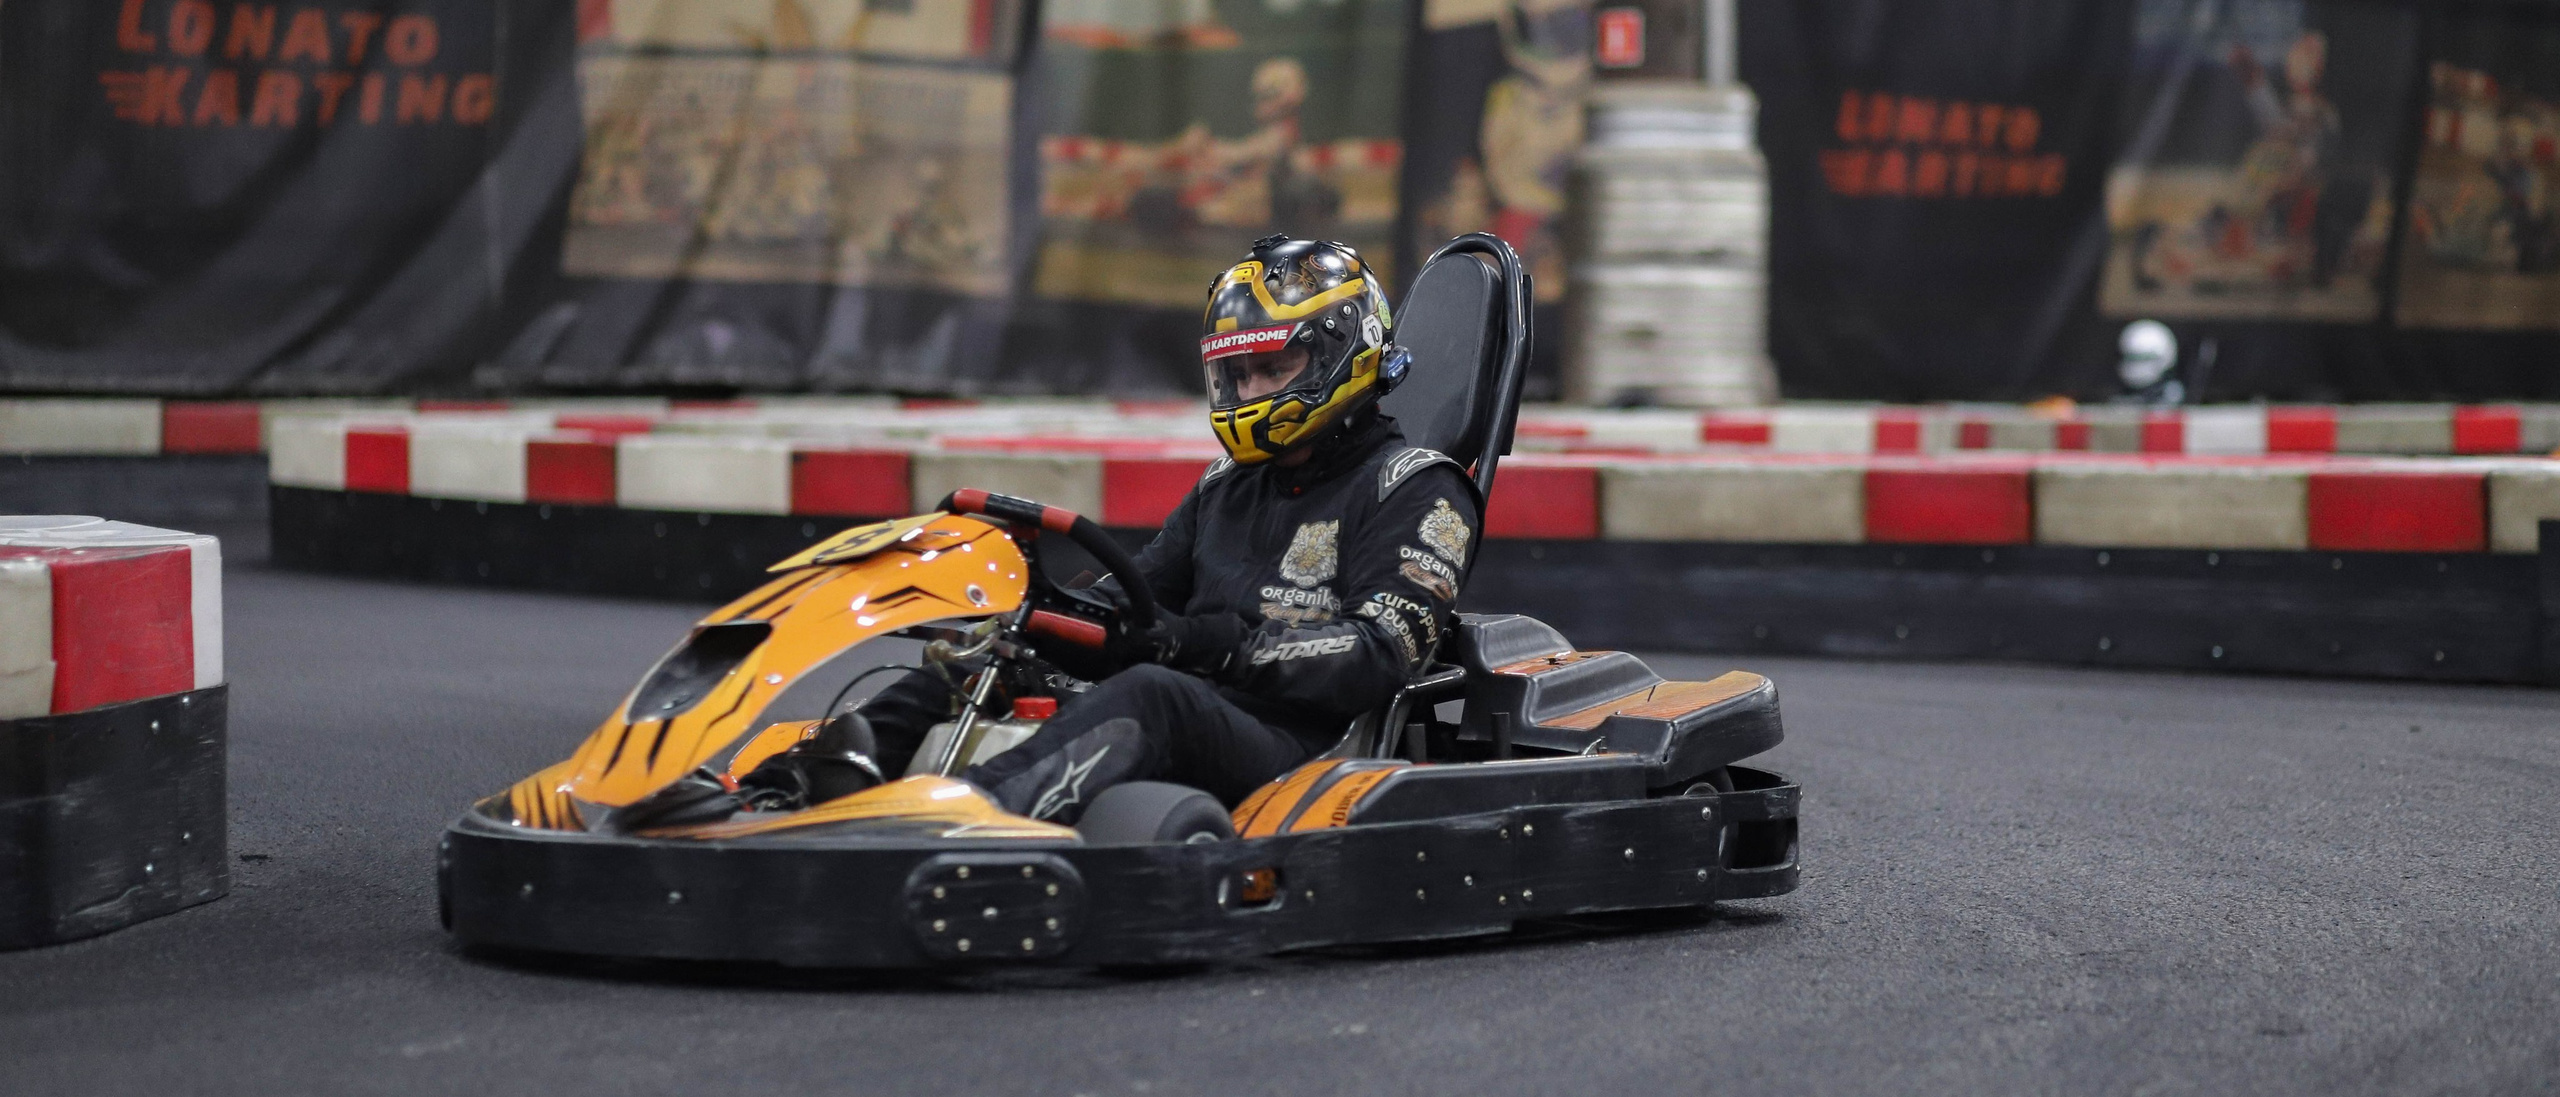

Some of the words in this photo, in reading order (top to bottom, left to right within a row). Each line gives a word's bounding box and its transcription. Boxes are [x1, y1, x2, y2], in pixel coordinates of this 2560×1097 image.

[116, 0, 440, 65] LONATO
[125, 66, 497, 127] KARTING
[1211, 329, 1289, 351] KARTDROME
